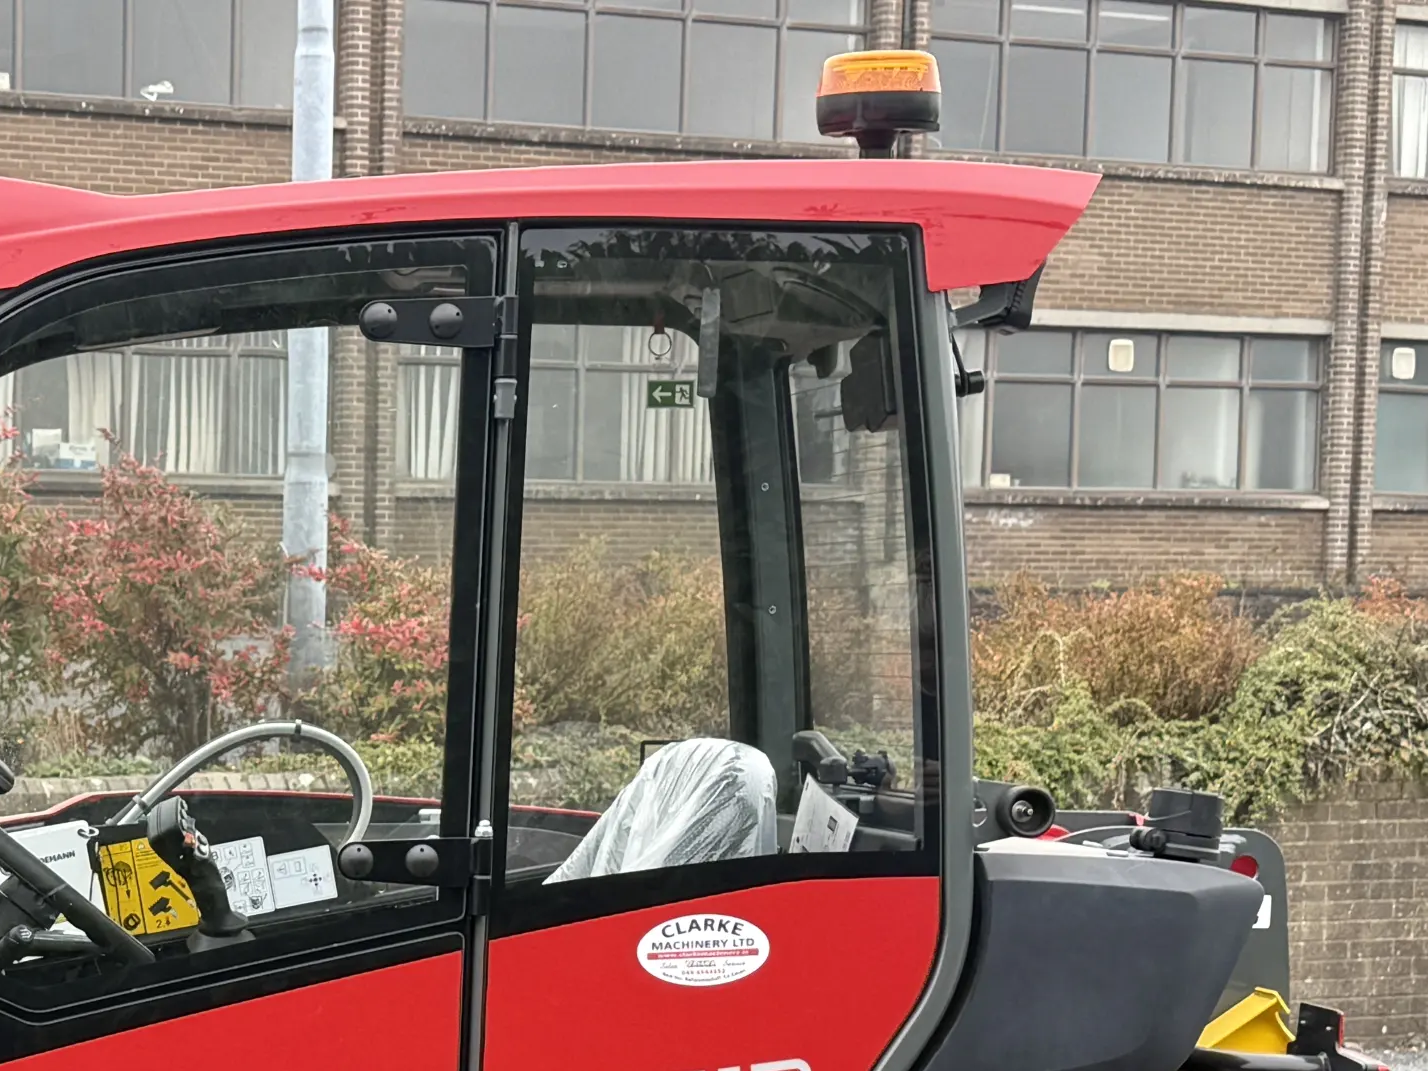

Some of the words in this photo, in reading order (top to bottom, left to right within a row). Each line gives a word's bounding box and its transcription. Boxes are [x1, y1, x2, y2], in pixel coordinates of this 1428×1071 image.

[661, 918, 745, 938] CLARKE
[651, 939, 728, 951] MACHINERY
[732, 938, 755, 947] LTD
